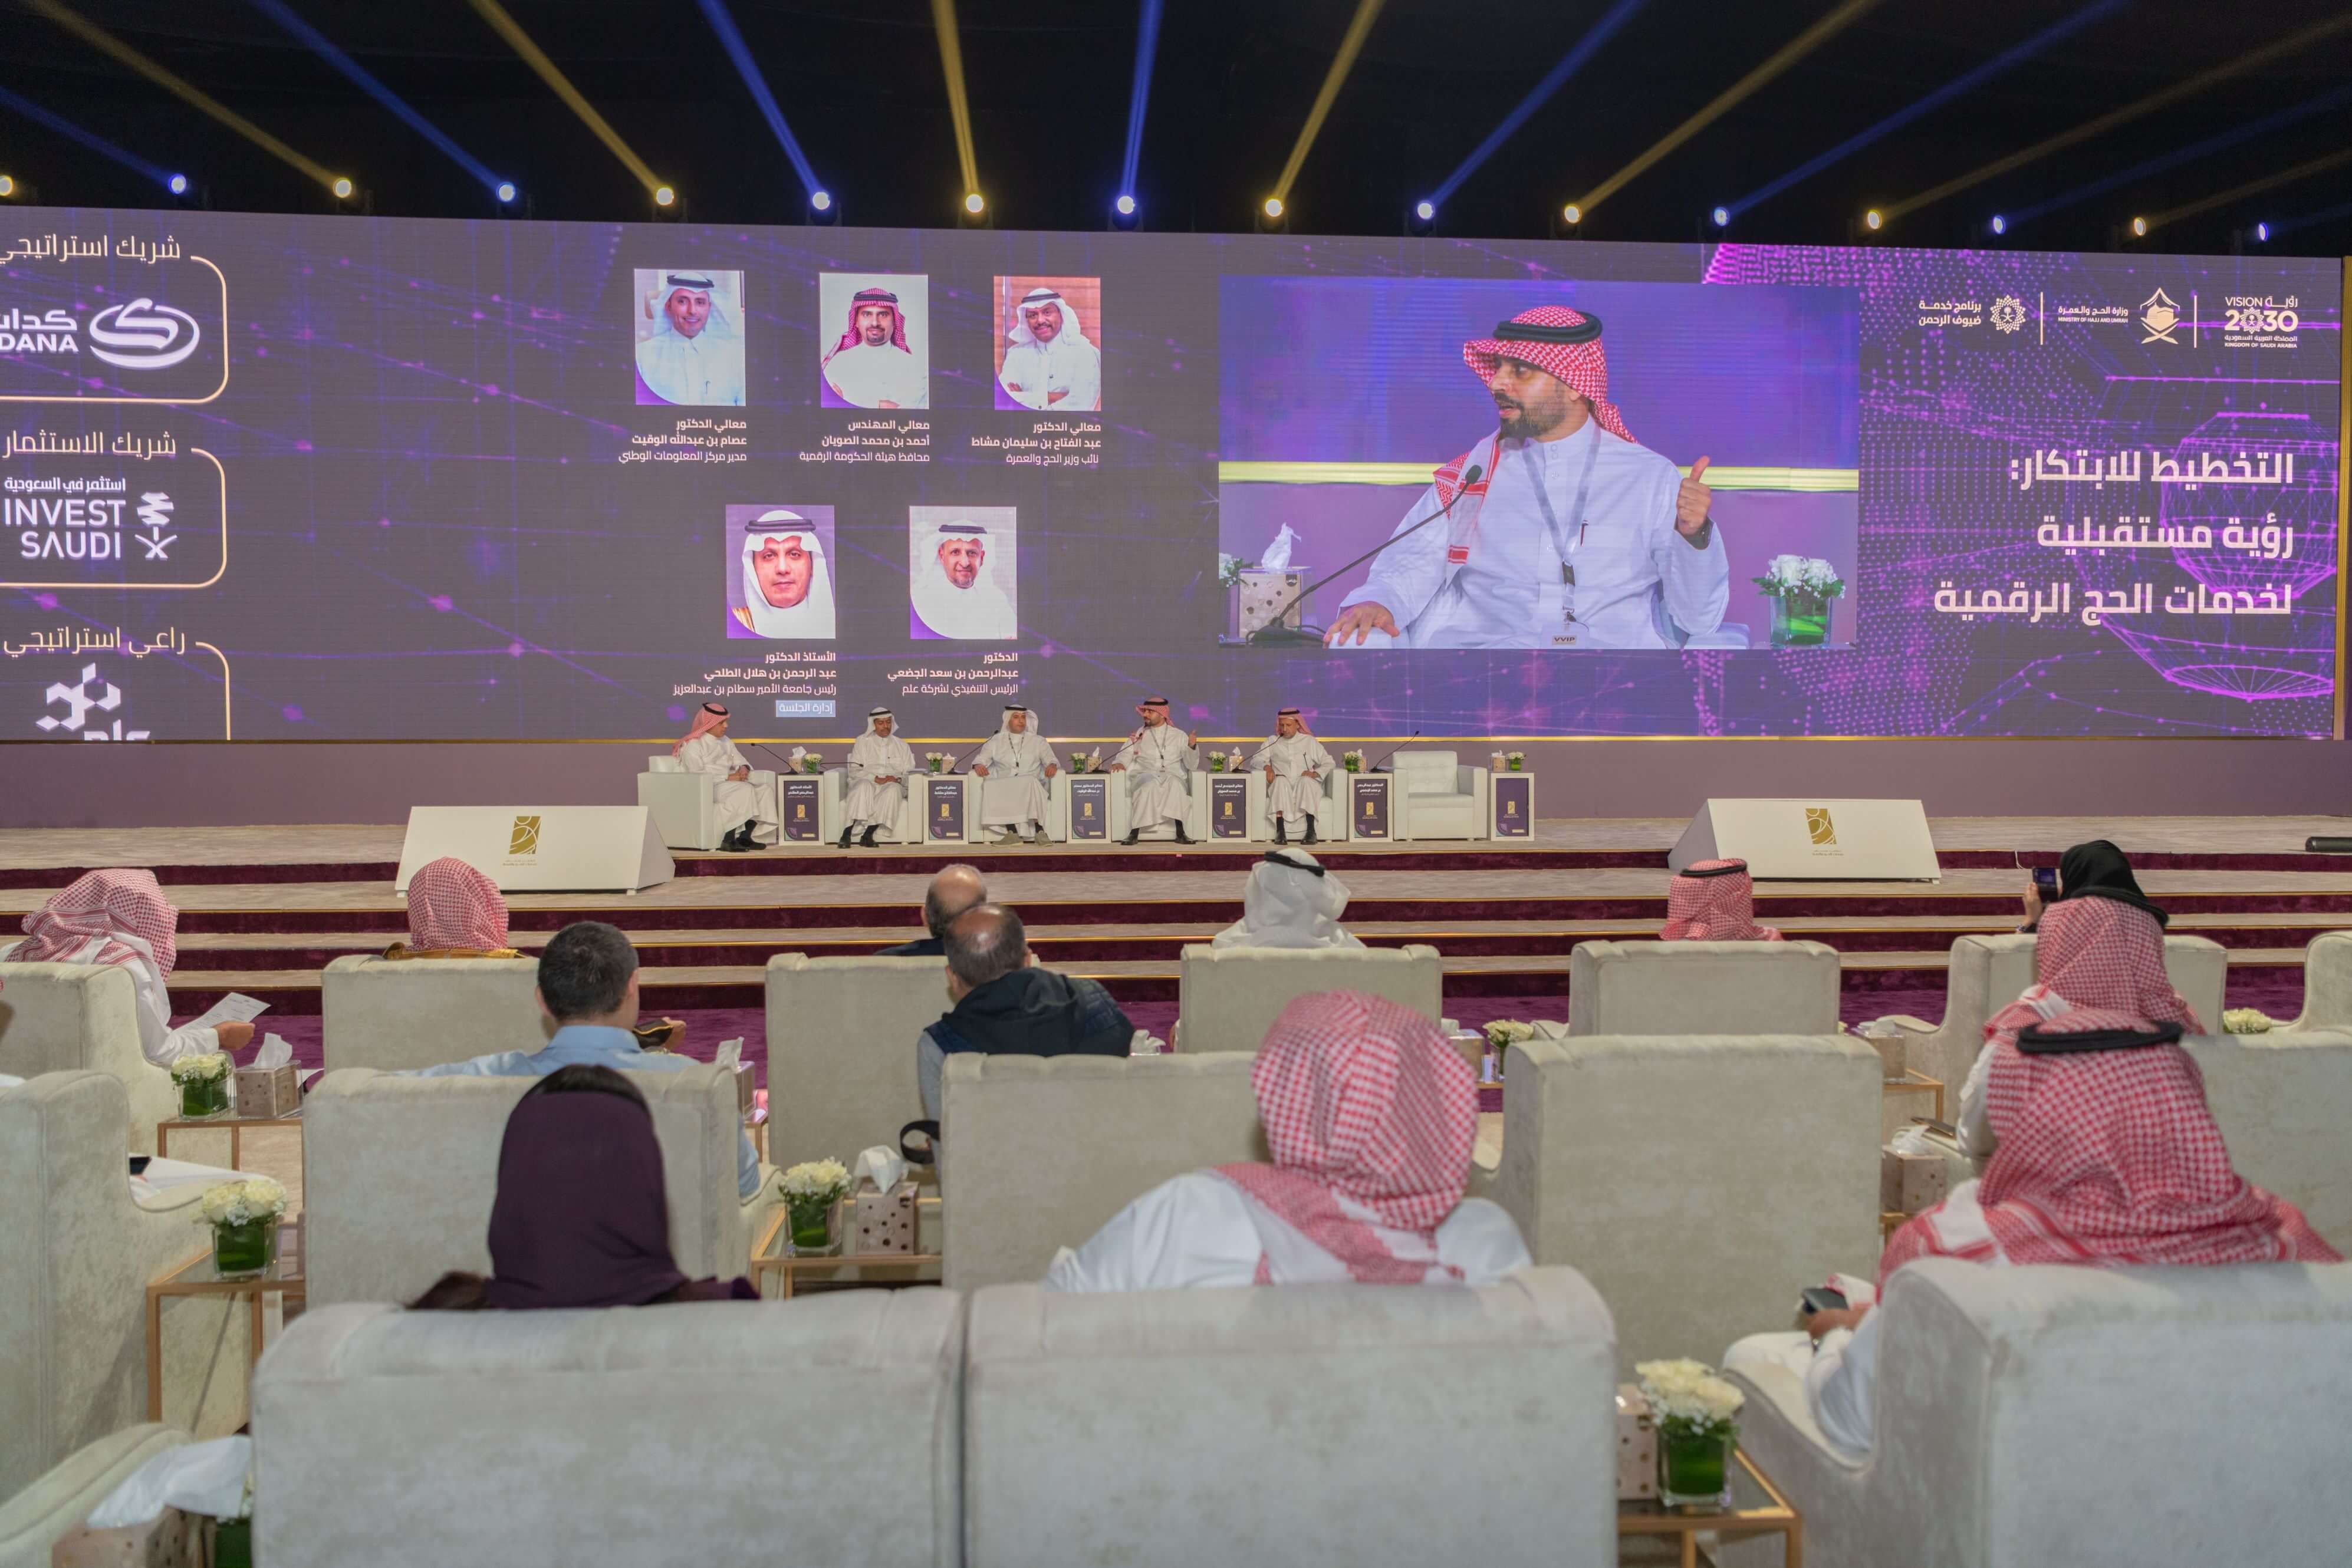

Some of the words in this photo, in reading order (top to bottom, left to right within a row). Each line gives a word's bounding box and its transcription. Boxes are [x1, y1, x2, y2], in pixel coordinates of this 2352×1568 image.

[0, 233, 107, 265] استراتيجي
[117, 236, 180, 264] شريك
[1954, 301, 1982, 314] برنامج
[2225, 297, 2262, 307] VISION
[2058, 306, 2090, 315] والعمرة
[2092, 307, 2110, 315] الحج
[2112, 307, 2129, 316] وزارة
[1919, 314, 1950, 327] الرحمن
[1952, 315, 1982, 328] ضيوف
[2225, 309, 2298, 332] 2030
[676, 418, 712, 430] الدكتور
[715, 419, 746, 433] معالي
[848, 420, 896, 431] المهندس
[898, 420, 930, 434] معالي
[1033, 421, 1067, 433] الدكتور
[1070, 422, 1101, 436] معالي
[2, 429, 103, 459] الاستثمار
[632, 434, 667, 446] الوقيت
[670, 431, 704, 446] عبدالله
[706, 436, 718, 447] بن
[721, 436, 747, 448] عصام
[821, 435, 859, 447] الصويان
[861, 437, 890, 446] محمد
[892, 437, 904, 447] بن
[906, 434, 930, 446] أحمد
[972, 436, 1000, 447] مشاط
[1002, 437, 1038, 449] سليمان
[1040, 439, 1051, 449] بن
[112, 431, 176, 460] شريك
[619, 450, 652, 464] الوطني
[654, 452, 703, 462] المعلومات
[705, 452, 725, 463] مركز
[727, 452, 746, 463] مدير
[800, 451, 831, 463] الرقمية
[834, 451, 873, 463] الحكومة
[875, 452, 896, 463] هيئة
[898, 452, 930, 462] محافظ
[1006, 453, 1041, 465] والعمرة
[1043, 454, 1061, 466] الحج
[1064, 455, 1079, 465] وزير
[1081, 454, 1099, 465] نائب
[2011, 449, 2141, 490] للابتكار:
[2151, 451, 2293, 490] التخطيط
[4, 476, 60, 492] السعودية
[63, 477, 84, 493] في
[85, 476, 126, 493] استثمر
[4, 498, 126, 526] INVEST
[2037, 515, 2212, 556] مستقبلية
[2222, 512, 2293, 559] رؤية
[21, 531, 121, 559] SAUDI
[1935, 581, 2070, 623] الرقمية
[2082, 582, 2152, 626] الحج
[2165, 583, 2291, 615] لخدمات
[4, 626, 120, 658] استراتيجي
[129, 627, 185, 658] راعي
[765, 651, 800, 663] الدكتور
[802, 651, 835, 661] الأستاذ
[983, 652, 1018, 664] الدكتور
[705, 668, 741, 681] الطلحي
[743, 668, 767, 679] هلال
[769, 669, 780, 680] بن
[887, 668, 927, 681] الجضعي
[929, 669, 952, 677] سعد
[955, 668, 966, 679] بن
[968, 668, 1018, 679] عبدالرحمن
[673, 683, 712, 696] عبدالعزيز
[714, 685, 725, 696] بن
[727, 683, 755, 697] سطام
[756, 683, 780, 696] الأمير
[782, 684, 812, 696] جامعة
[814, 684, 836, 696] رئيس
[902, 684, 919, 697] علم
[921, 684, 949, 696] لشركة
[951, 684, 988, 697] التنفيذي
[991, 684, 1018, 696] الرئيس
[779, 702, 810, 713] الجلسة
[812, 702, 833, 714] إدارة
